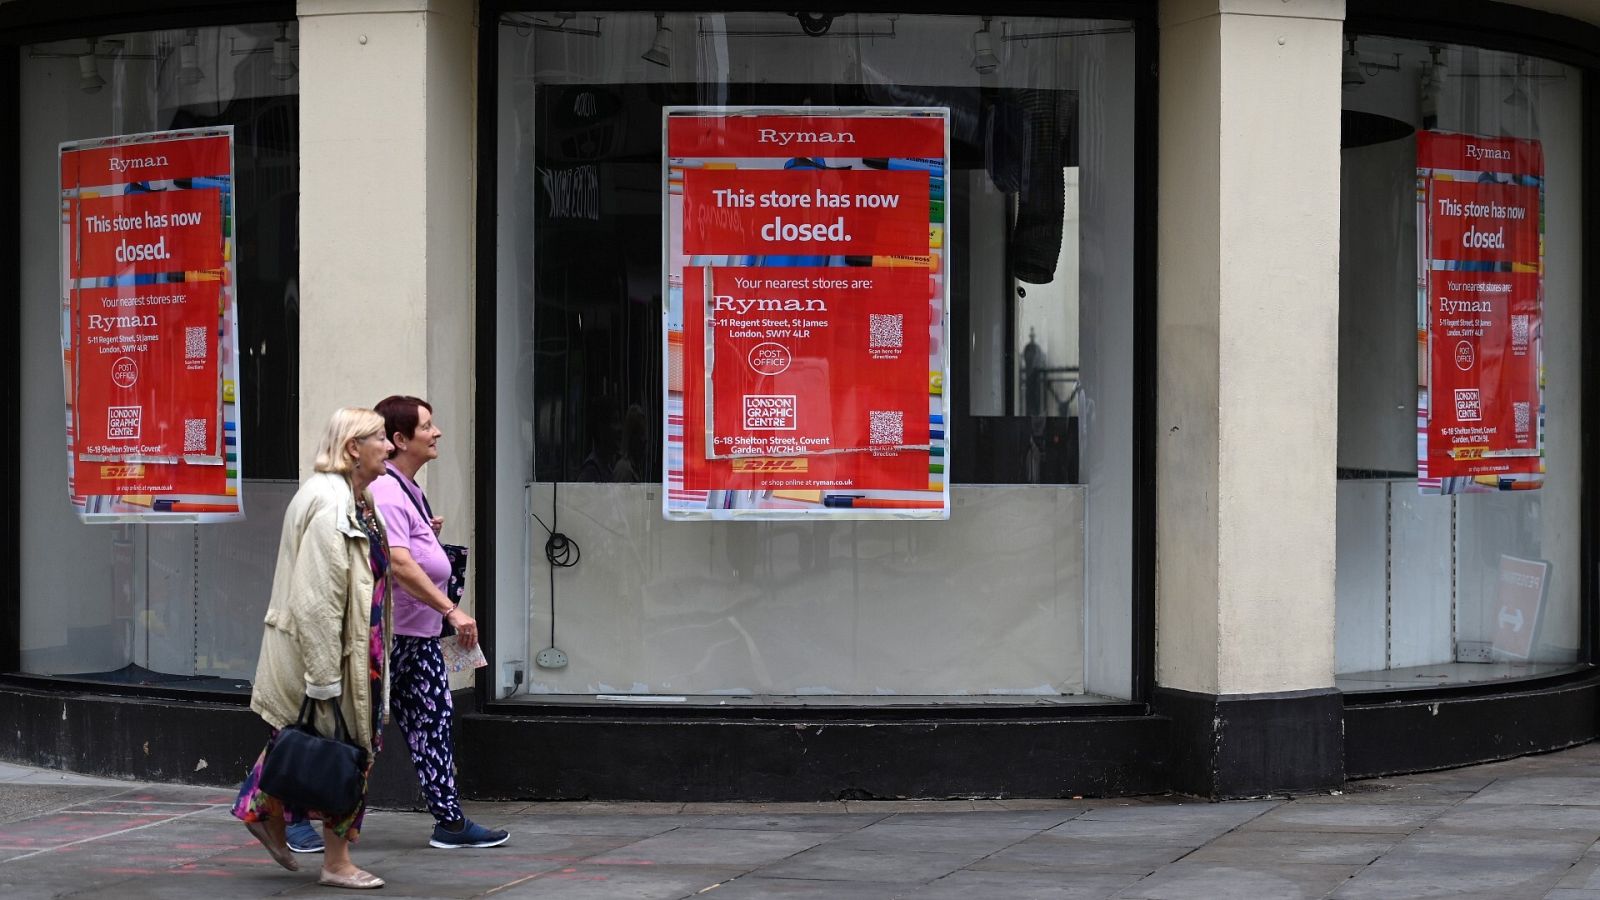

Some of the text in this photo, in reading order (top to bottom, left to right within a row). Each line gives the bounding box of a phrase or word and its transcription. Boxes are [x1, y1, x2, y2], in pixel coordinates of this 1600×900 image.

[758, 129, 856, 146] Ryman
[1465, 144, 1511, 161] Ryman
[108, 155, 169, 173] Ryman
[712, 189, 899, 208] This store has now
[1438, 198, 1526, 220] This store has now
[85, 211, 202, 234] This store has now
[761, 216, 852, 242] closed.
[1462, 224, 1505, 249] closed.
[115, 235, 170, 263] closed.
[735, 277, 873, 289] Your nearest stores are:
[1447, 281, 1462, 291] Your
[1462, 282, 1486, 292] nearest
[101, 294, 187, 308] Your nearest stores are:
[713, 295, 827, 315] Ryman
[1439, 297, 1492, 315] Ryman
[87, 314, 158, 332] Ryman
[729, 319, 761, 329] Regent
[761, 319, 791, 328] Street,
[792, 319, 802, 327] St
[803, 319, 829, 328] James
[98, 335, 119, 345] Regent
[141, 334, 159, 342] James
[729, 330, 810, 339] London, SW1Y 4LR
[759, 350, 782, 358] POST
[753, 358, 785, 366] OFFICE
[118, 363, 133, 372] POST
[115, 371, 135, 379] OFFICE
[1456, 392, 1478, 401] LONDON
[747, 398, 792, 408] LONDON
[1457, 401, 1479, 410] GRAPHIC
[110, 409, 139, 418] LONDON
[747, 408, 793, 417] GRAPHIC
[110, 418, 139, 427] GRAPHIC
[747, 417, 786, 426] CENTRE
[110, 427, 134, 436] CENTRE
[734, 436, 768, 445] Shelton
[769, 436, 798, 446] Street,
[799, 436, 830, 445] Covent
[101, 445, 123, 453] Shelton
[140, 444, 161, 453] Covent
[730, 446, 765, 455] Garden,
[766, 446, 794, 454] WC2H
[743, 460, 798, 470] DHL
[768, 479, 784, 487] shop
[813, 479, 853, 487] ryman.co.uk
